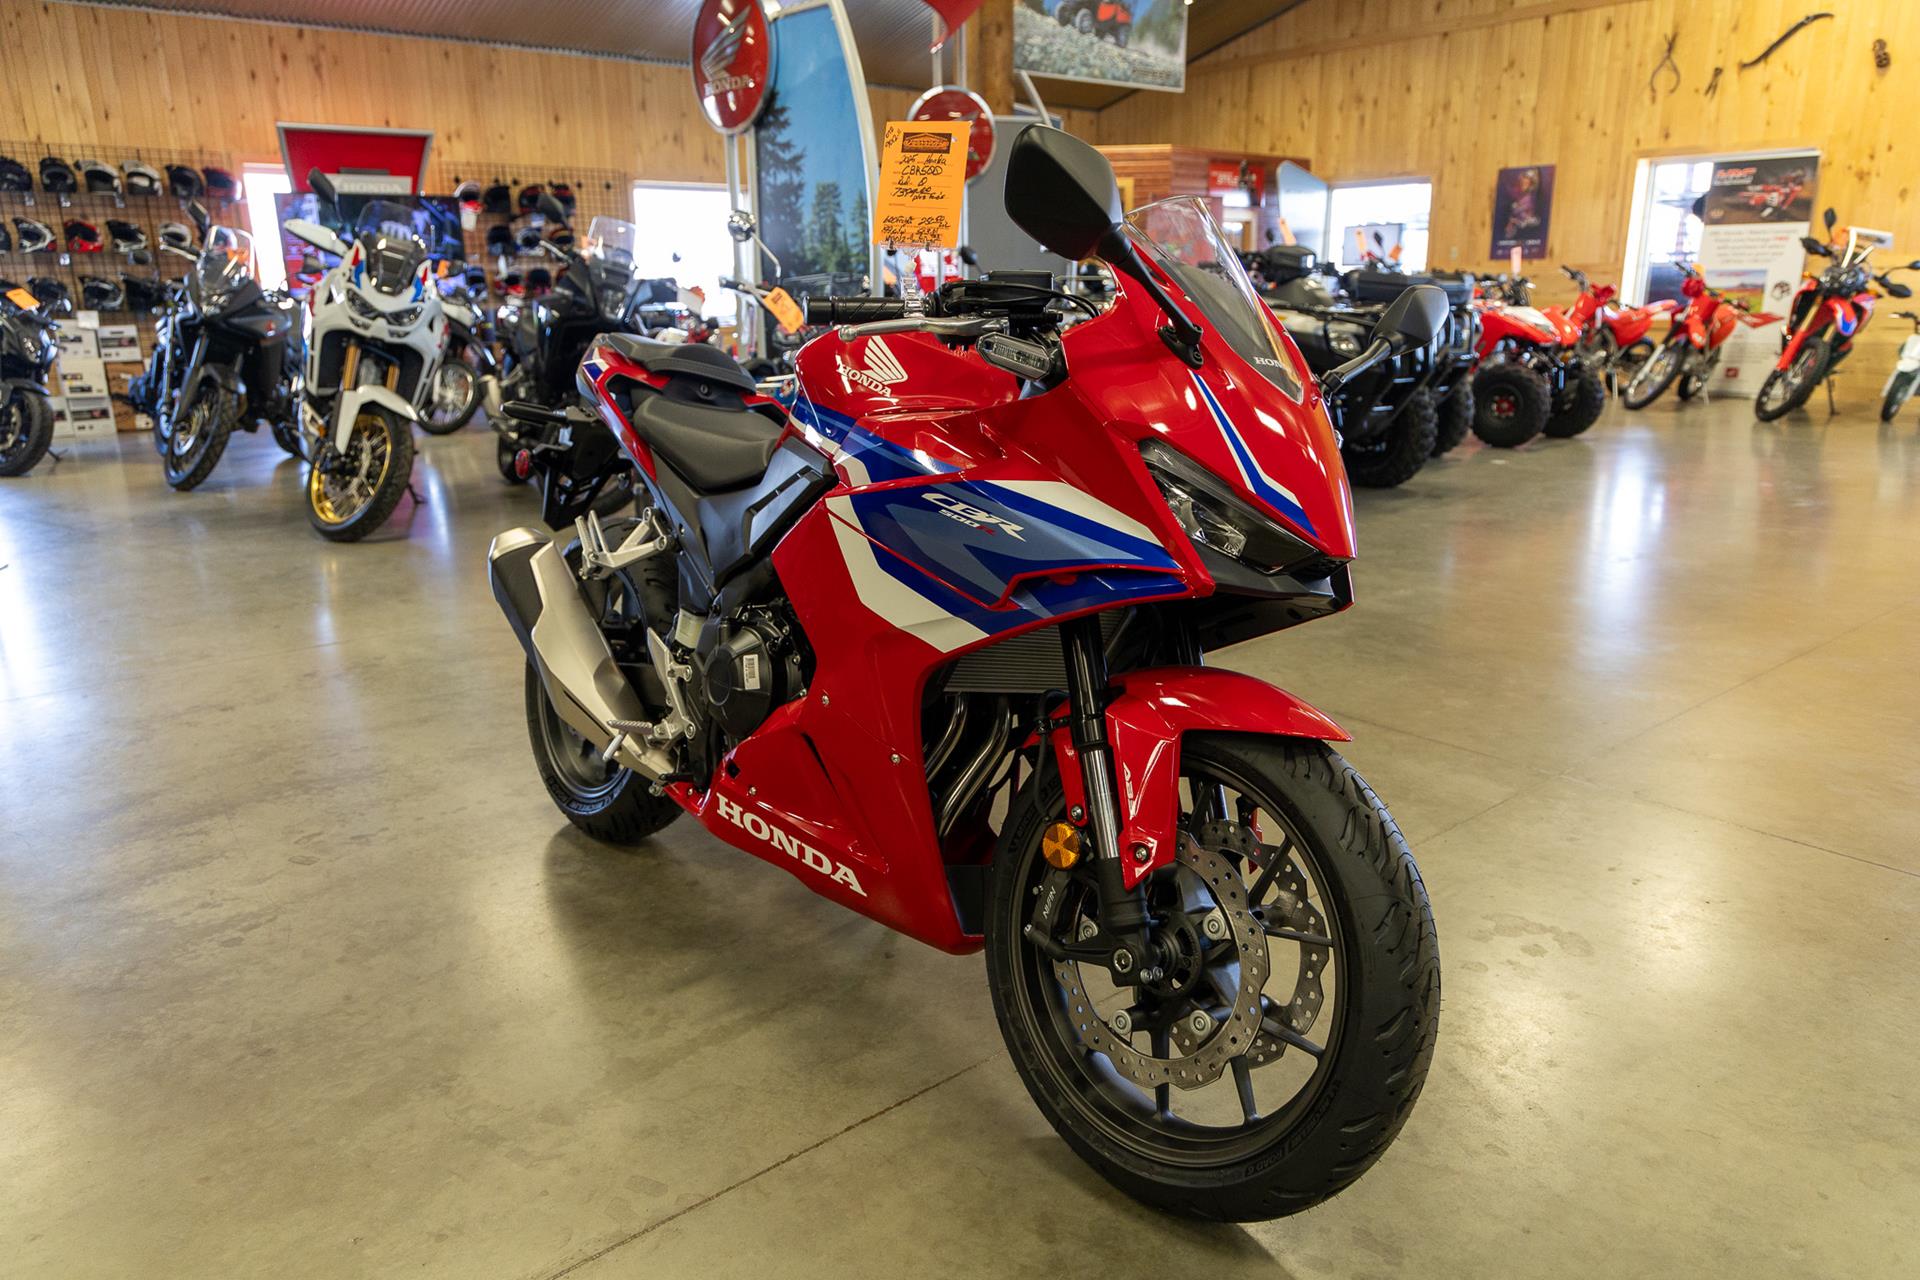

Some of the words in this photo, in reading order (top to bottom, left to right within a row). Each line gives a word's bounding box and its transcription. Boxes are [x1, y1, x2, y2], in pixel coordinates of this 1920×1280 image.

[704, 75, 751, 96] HONDA
[836, 363, 892, 398] HONDA
[921, 492, 1027, 542] CBR
[938, 508, 998, 537] 500R
[716, 792, 868, 897] HONDA
[1042, 885, 1057, 920] NISSIN
